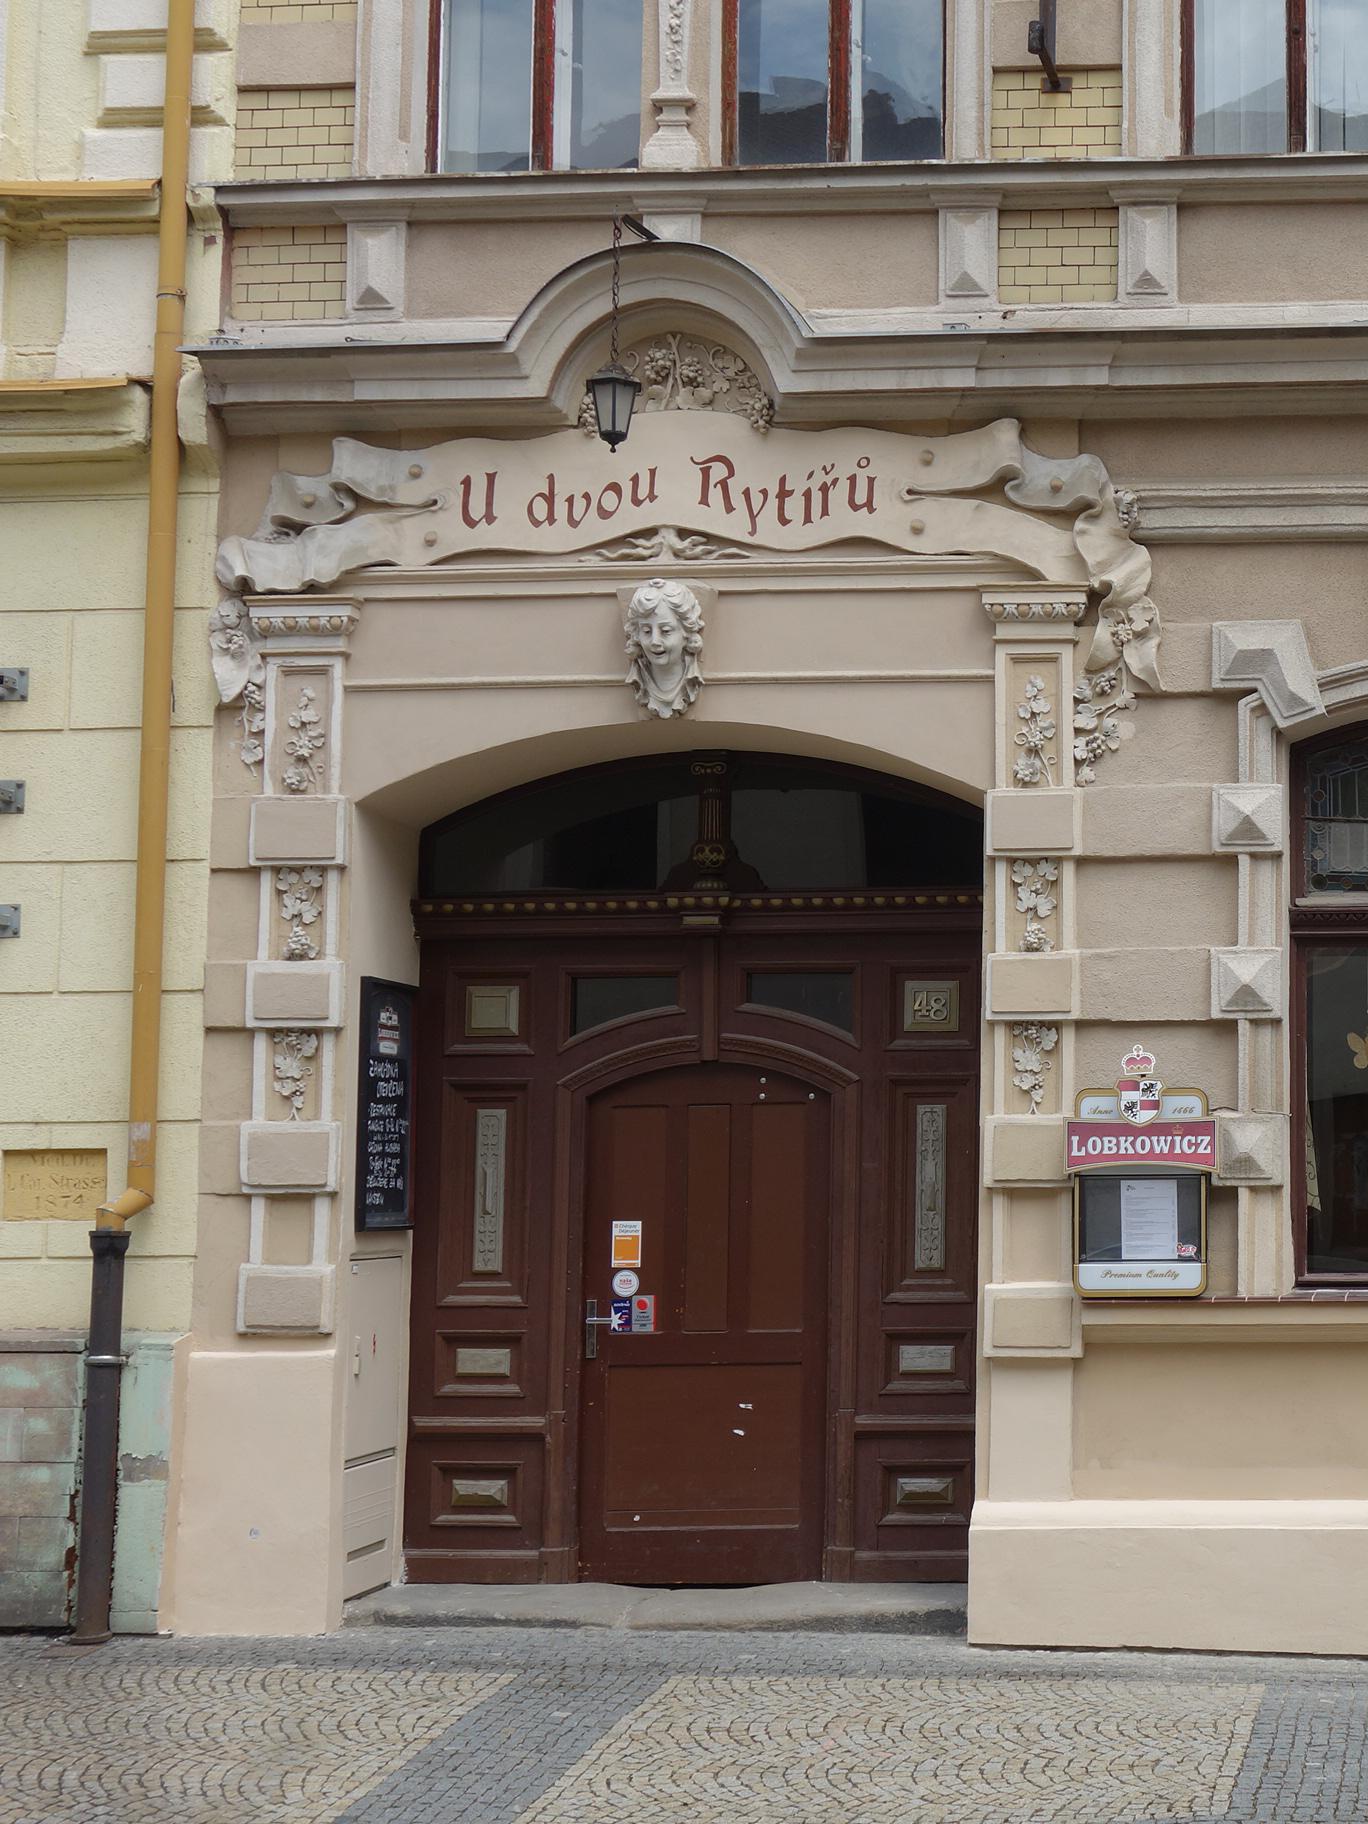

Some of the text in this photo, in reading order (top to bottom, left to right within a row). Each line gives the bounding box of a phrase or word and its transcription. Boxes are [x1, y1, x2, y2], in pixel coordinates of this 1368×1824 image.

[460, 454, 879, 537] U dvou Rytířů
[914, 991, 948, 1021] 48
[1086, 1105, 1114, 1115] Anno
[1070, 1135, 1212, 1157] LOBKOWICZ
[1100, 1269, 1180, 1281] Premium Quality
